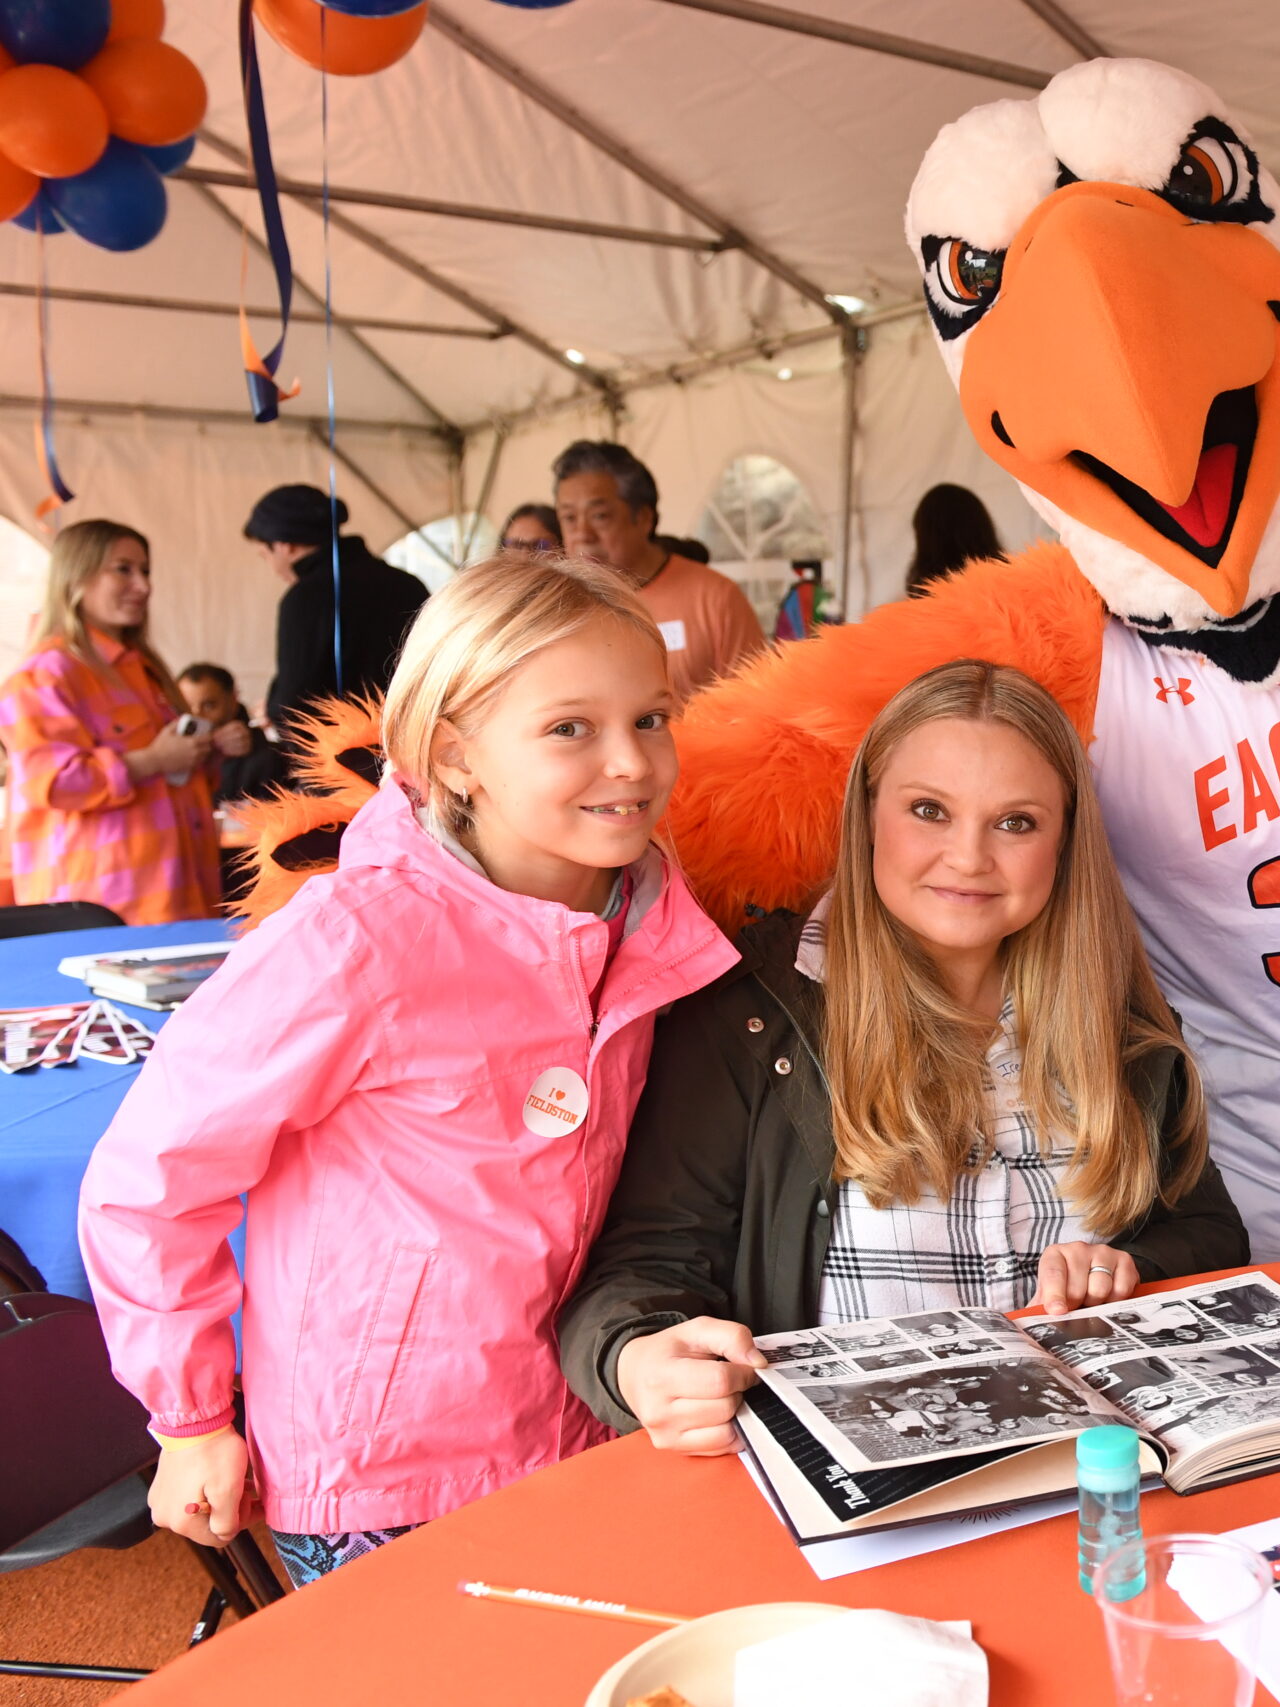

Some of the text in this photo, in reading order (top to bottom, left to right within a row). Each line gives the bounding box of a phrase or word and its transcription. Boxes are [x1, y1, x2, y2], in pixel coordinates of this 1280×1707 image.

[548, 1087, 556, 1098] I
[526, 1094, 579, 1125] FIELDSTON
[823, 1464, 871, 1510] Thank You
